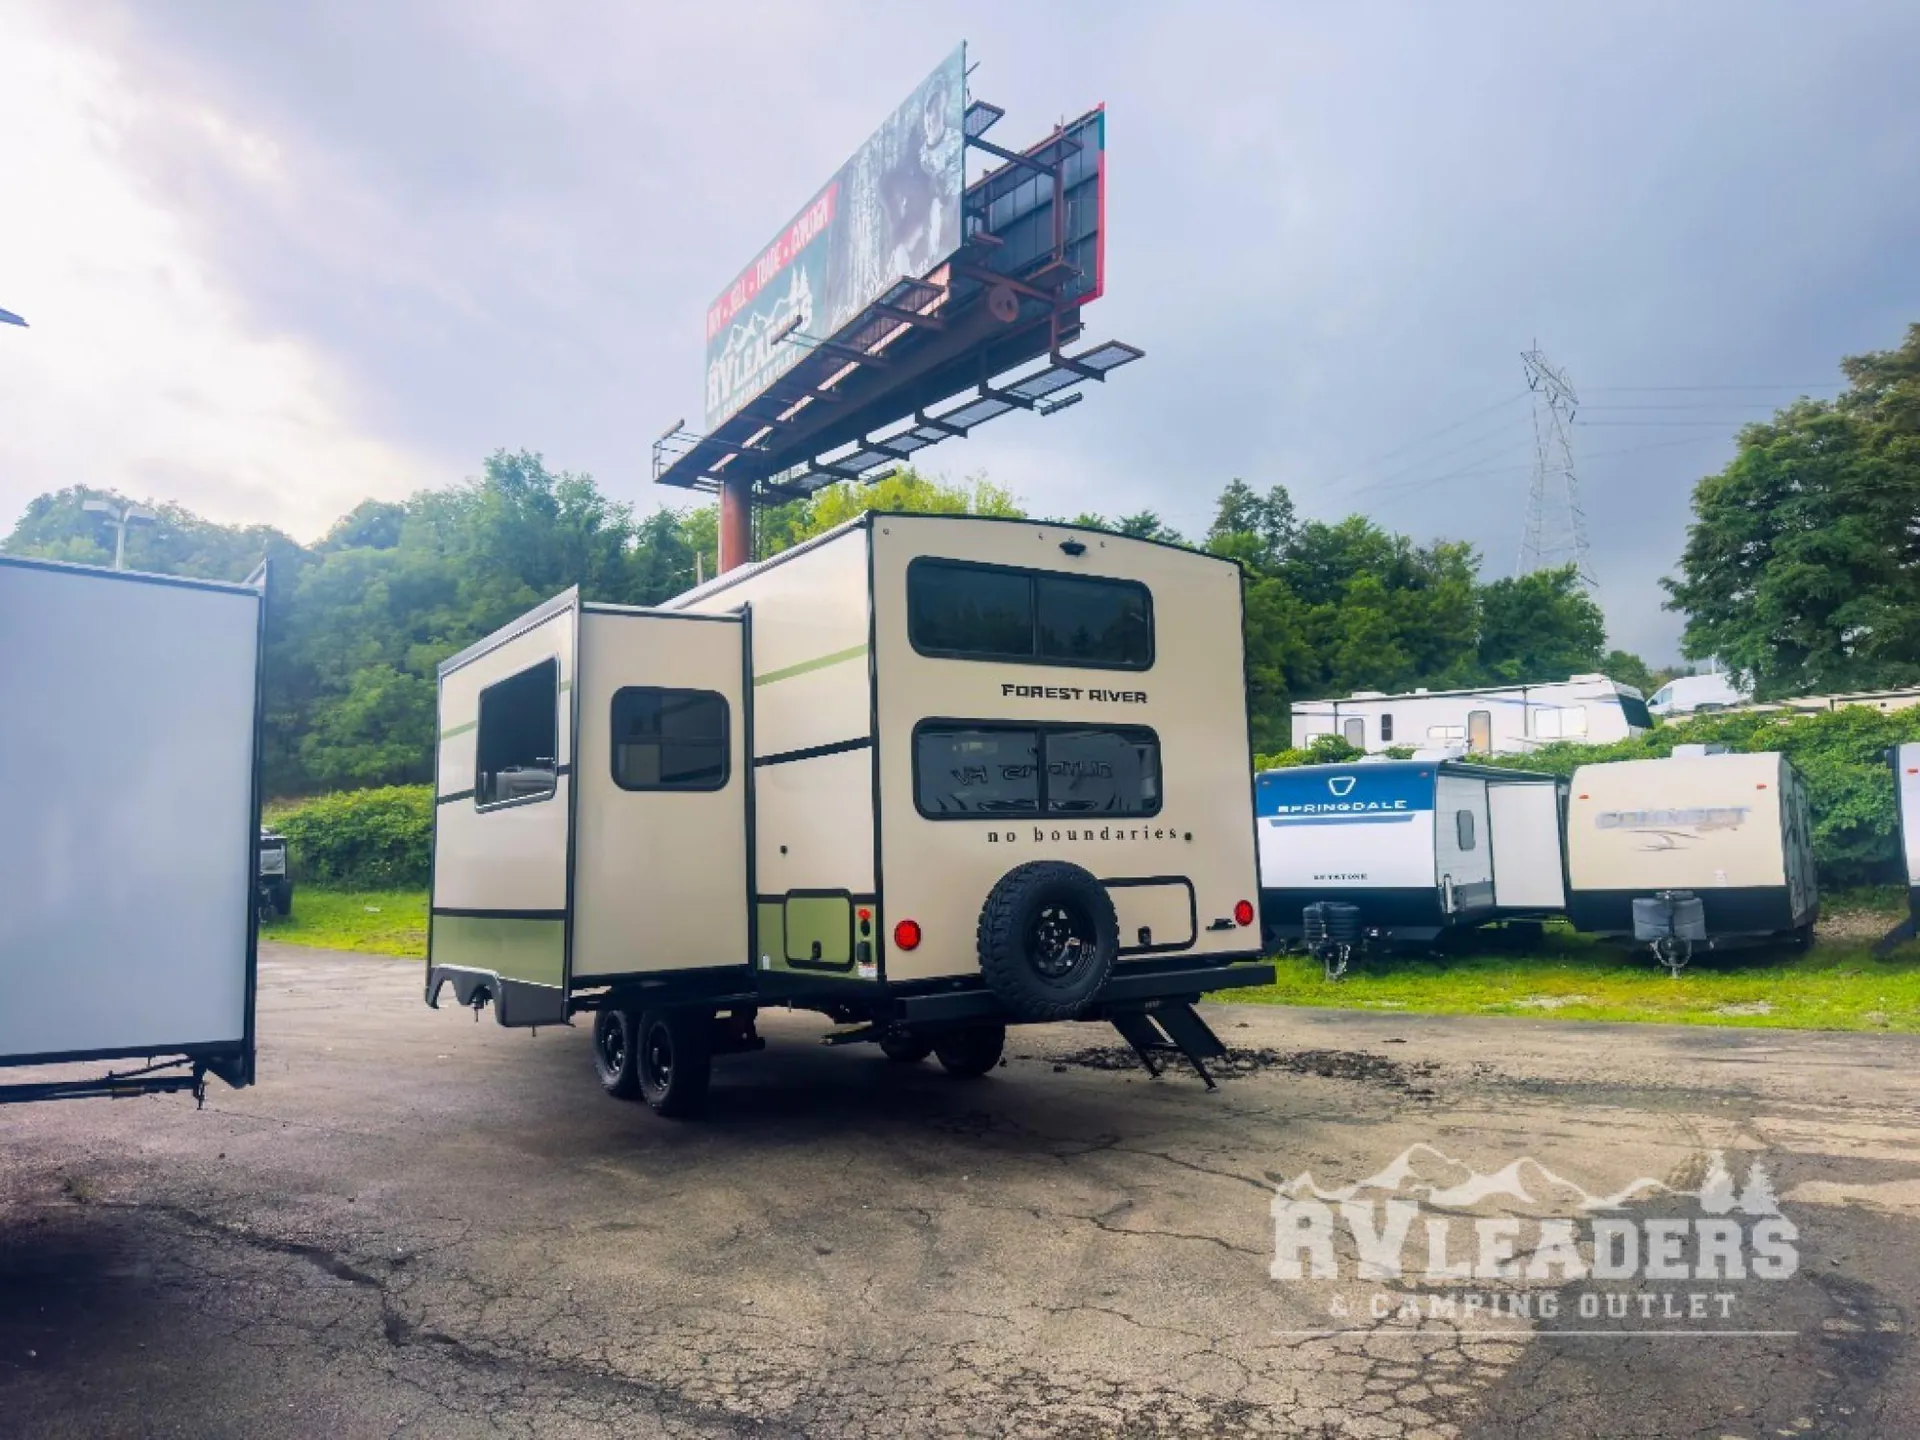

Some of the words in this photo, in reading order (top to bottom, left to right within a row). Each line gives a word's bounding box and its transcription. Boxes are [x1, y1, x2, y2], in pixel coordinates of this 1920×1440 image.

[1001, 683, 1084, 700] FOREST
[1088, 689, 1148, 704] RIVER
[987, 831, 1016, 843] no
